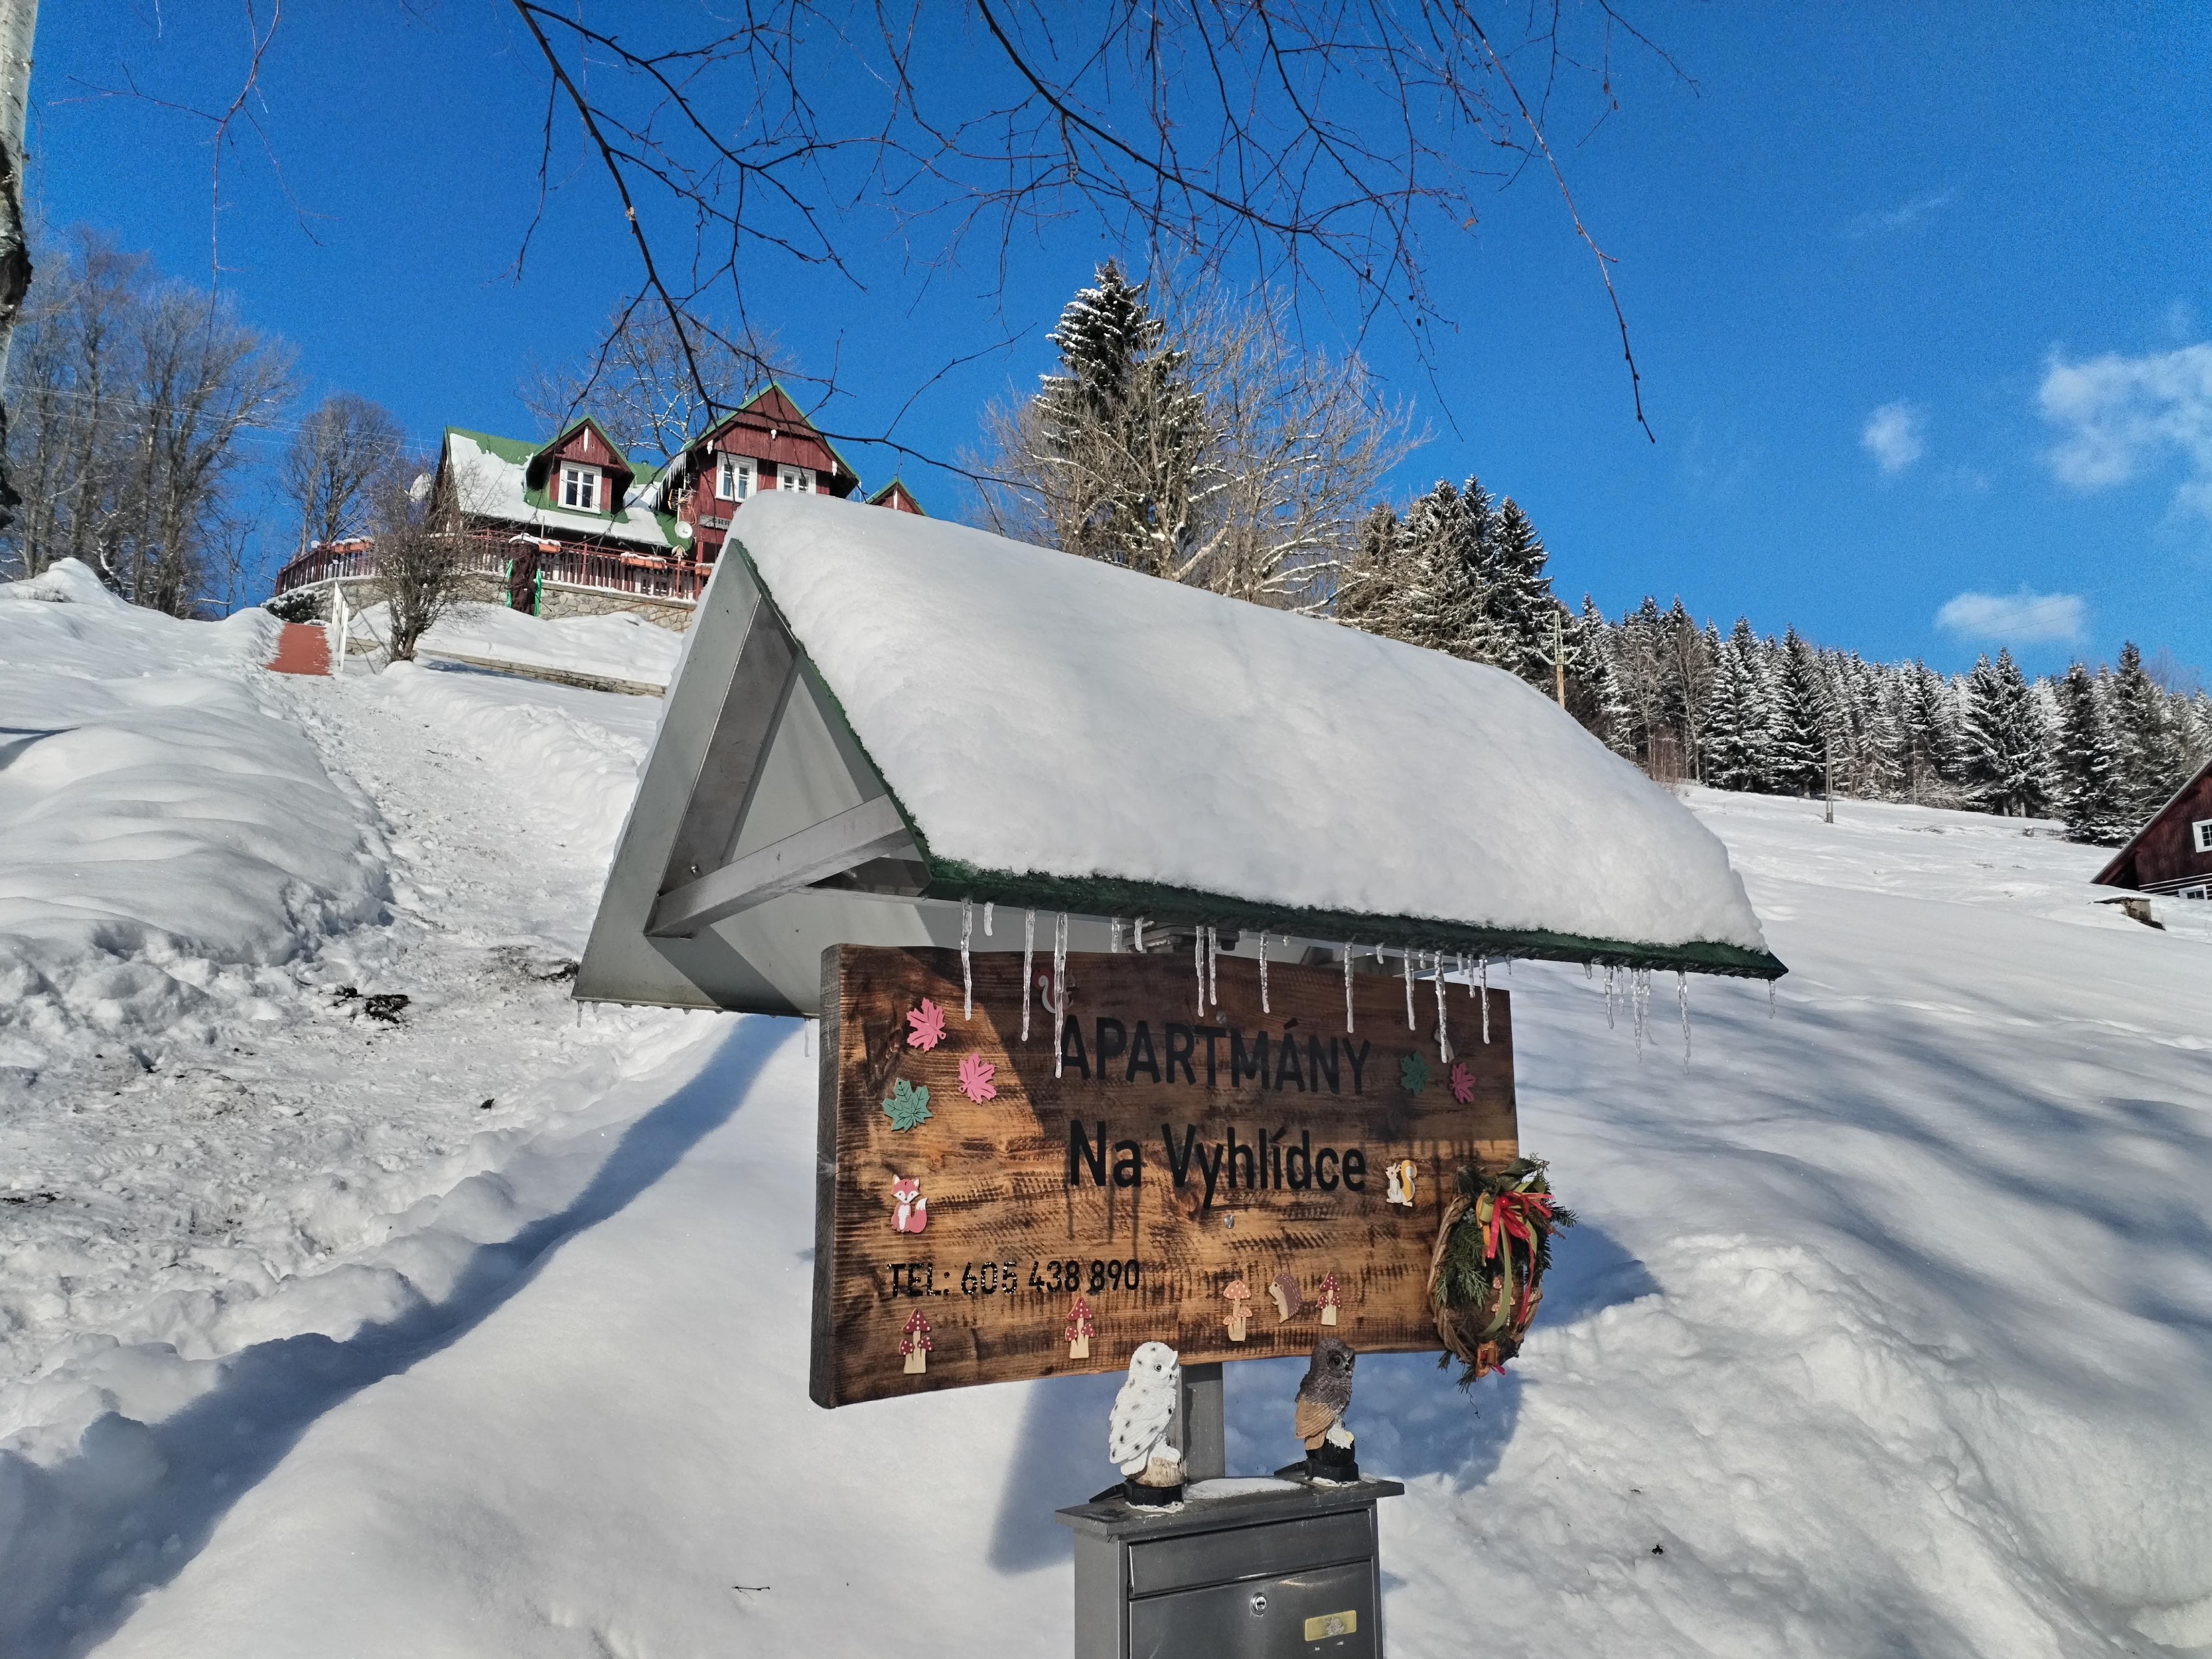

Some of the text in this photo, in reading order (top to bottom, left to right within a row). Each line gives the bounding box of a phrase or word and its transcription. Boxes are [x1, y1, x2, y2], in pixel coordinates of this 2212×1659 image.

[1055, 1014, 1370, 1094] APARTMÁNY
[1070, 1120, 1366, 1209] Na Vyhlídce
[961, 1261, 1018, 1295] 605
[1029, 1260, 1081, 1293] 438
[1090, 1259, 1140, 1292] 890
